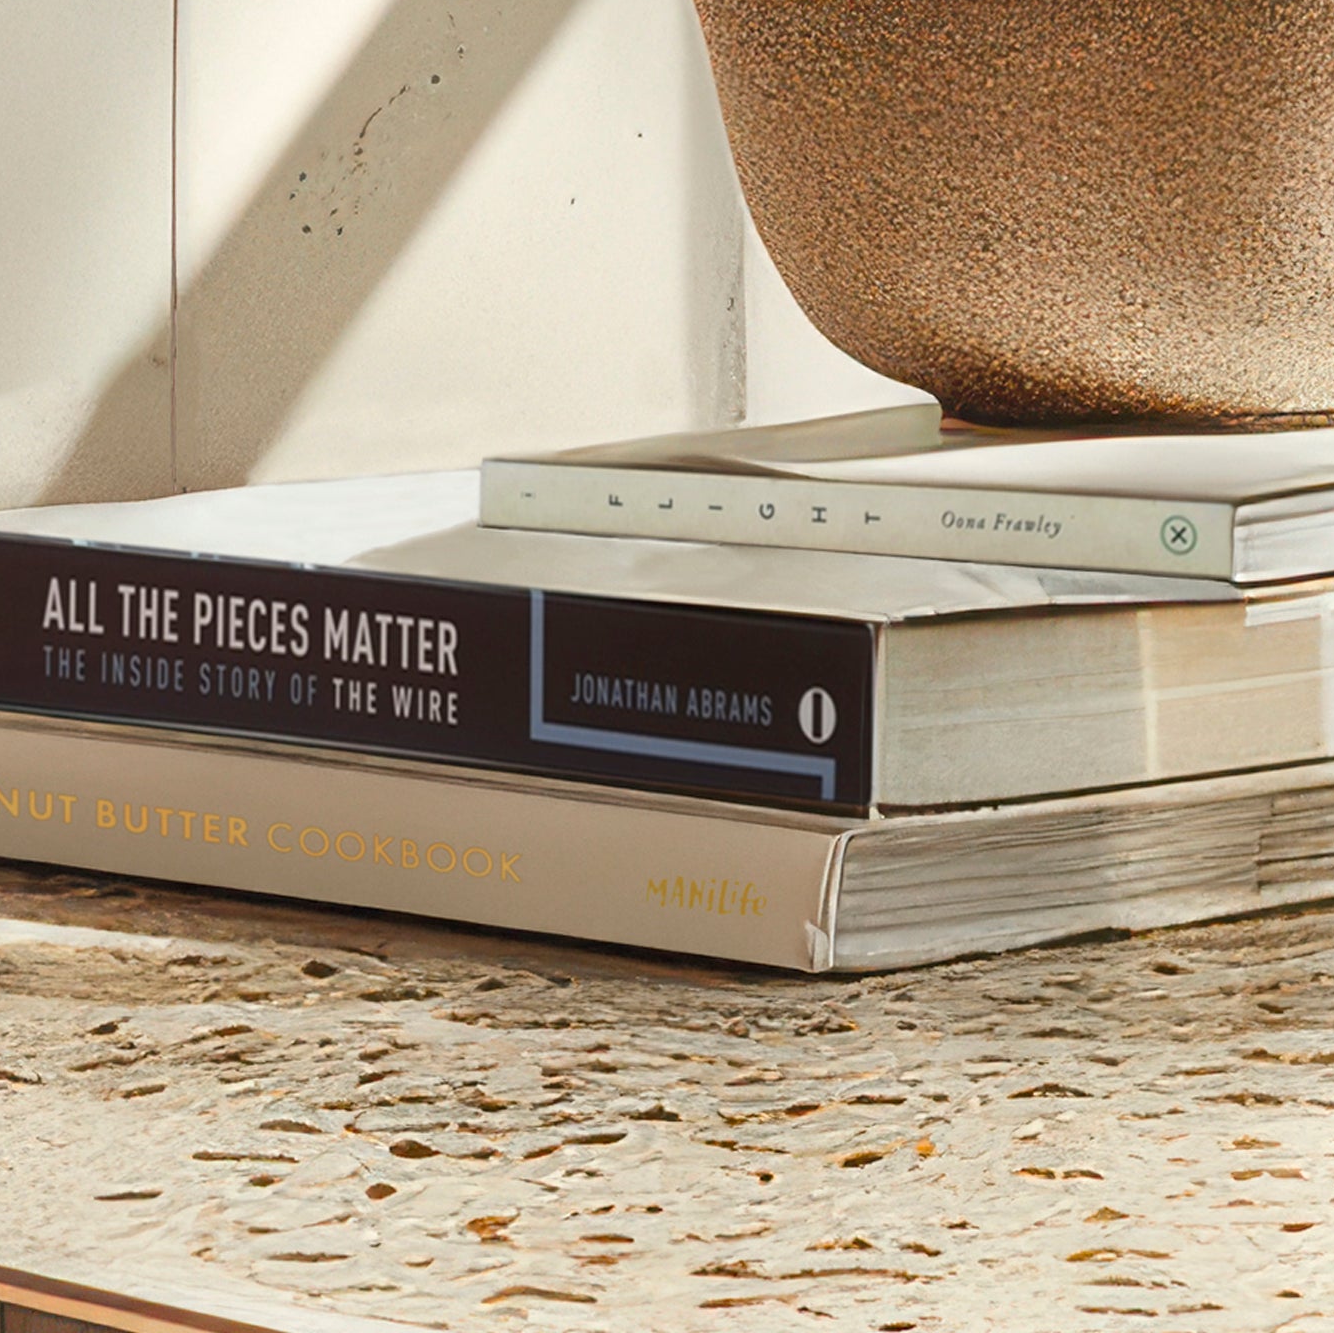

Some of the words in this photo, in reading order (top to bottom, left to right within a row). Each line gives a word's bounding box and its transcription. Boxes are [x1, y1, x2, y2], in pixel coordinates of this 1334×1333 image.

[941, 511, 986, 530] Oona
[993, 512, 1063, 539] Frawley
[42, 576, 105, 634] ALL
[117, 584, 180, 643] THE
[193, 592, 310, 658] PIECES
[323, 606, 459, 676] MATTER
[42, 645, 87, 683] THE
[100, 651, 185, 693] INSIDE
[198, 661, 277, 703] STORY
[289, 672, 319, 707] OF
[332, 677, 378, 716] THE
[391, 685, 460, 726] WIRE
[570, 673, 679, 715] JONATHAN
[685, 687, 773, 727] ABRAMS
[95, 799, 249, 848] BUTTER
[267, 822, 523, 884] COOKBOOK
